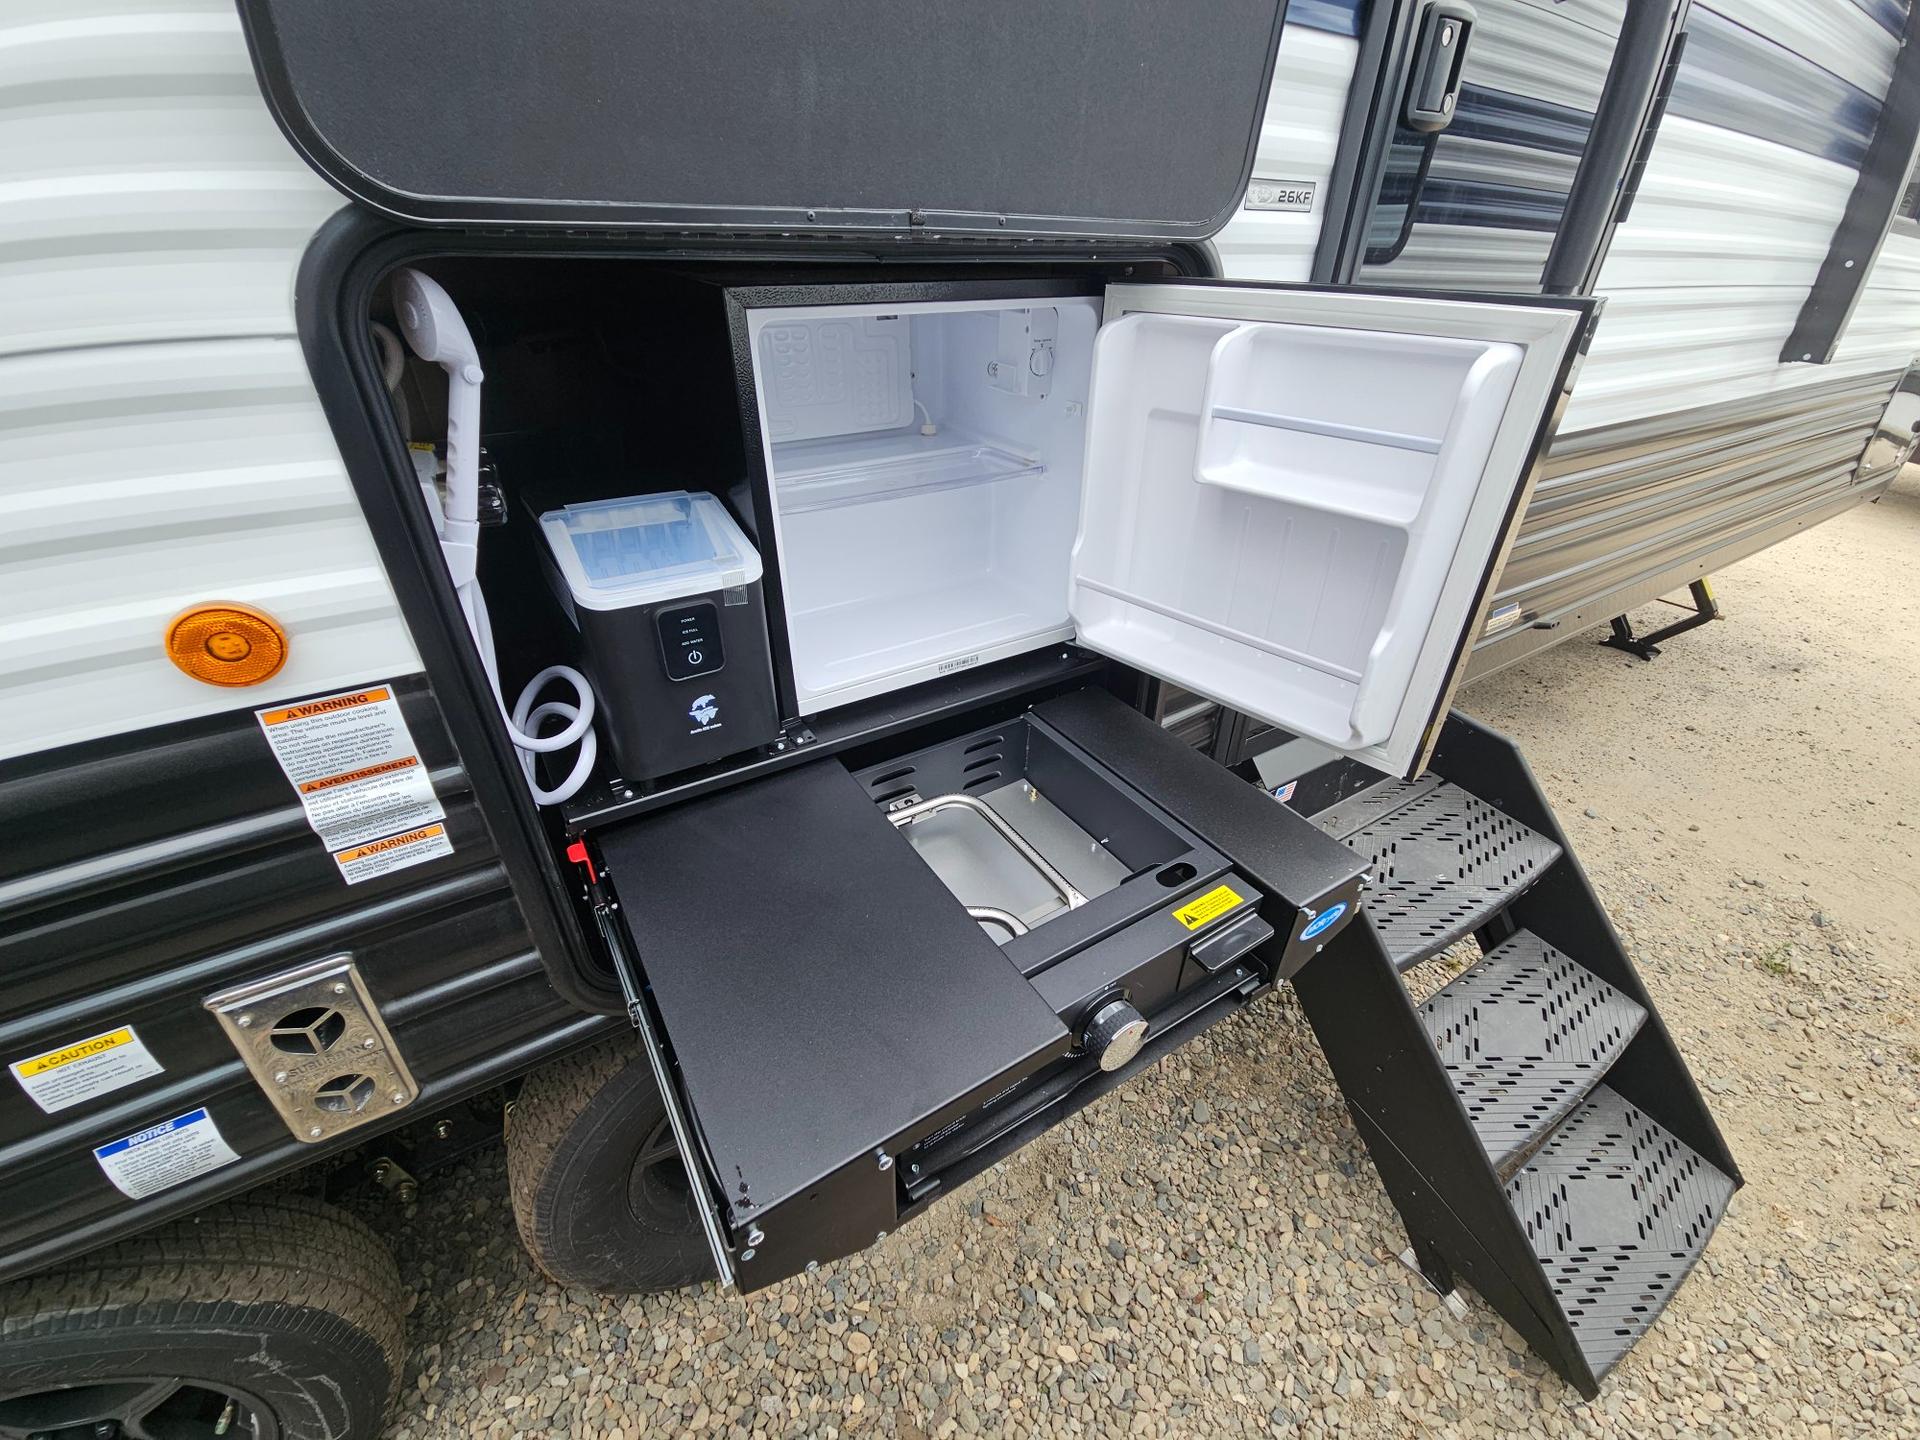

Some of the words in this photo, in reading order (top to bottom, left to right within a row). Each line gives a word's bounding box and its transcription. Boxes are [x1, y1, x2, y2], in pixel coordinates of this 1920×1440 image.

[1278, 190, 1312, 204] 26KF
[298, 694, 369, 716] WARNING
[319, 758, 414, 788] AVERTISSEMENT
[367, 830, 427, 854] WARNING
[49, 1037, 116, 1065] CAUTION
[288, 1043, 366, 1078] SUBURBAN
[128, 1121, 175, 1146] NOTICE
